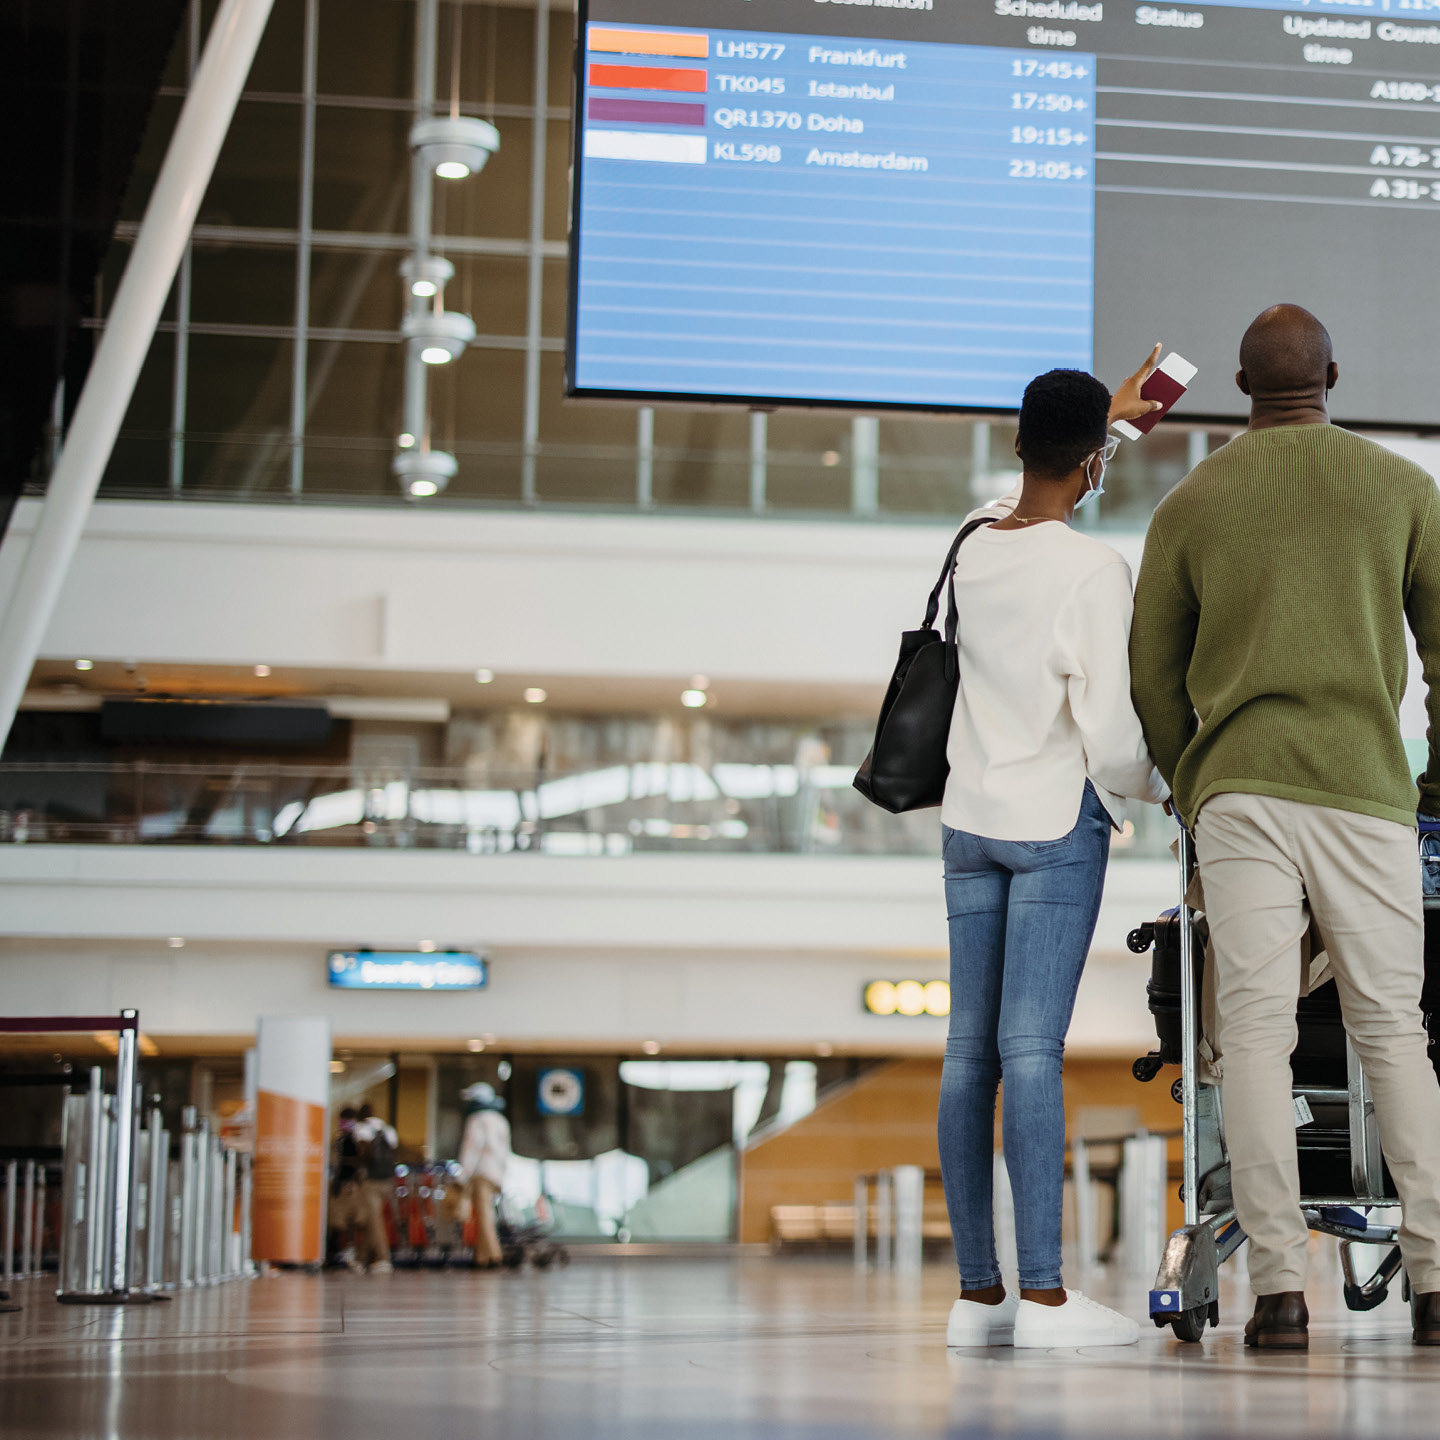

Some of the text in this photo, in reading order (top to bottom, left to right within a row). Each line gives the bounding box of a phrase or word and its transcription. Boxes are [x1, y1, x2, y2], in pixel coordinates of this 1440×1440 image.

[995, 0, 1102, 21] Scheduled
[1135, 6, 1203, 28] Status
[1283, 16, 1371, 39] Updated
[1027, 27, 1076, 47] time
[717, 41, 785, 60] LH577
[809, 46, 906, 69] Frankfurt
[1011, 60, 1088, 79] 17:45+
[718, 74, 1087, 112] TK045 Istanbul 17:50+
[715, 108, 801, 130] QR1370
[807, 114, 863, 133] Doha
[1010, 127, 1087, 145] 19:15+
[714, 143, 781, 162] KL598
[806, 149, 928, 171] Amsterdam
[1009, 160, 1087, 179] 23:05+
